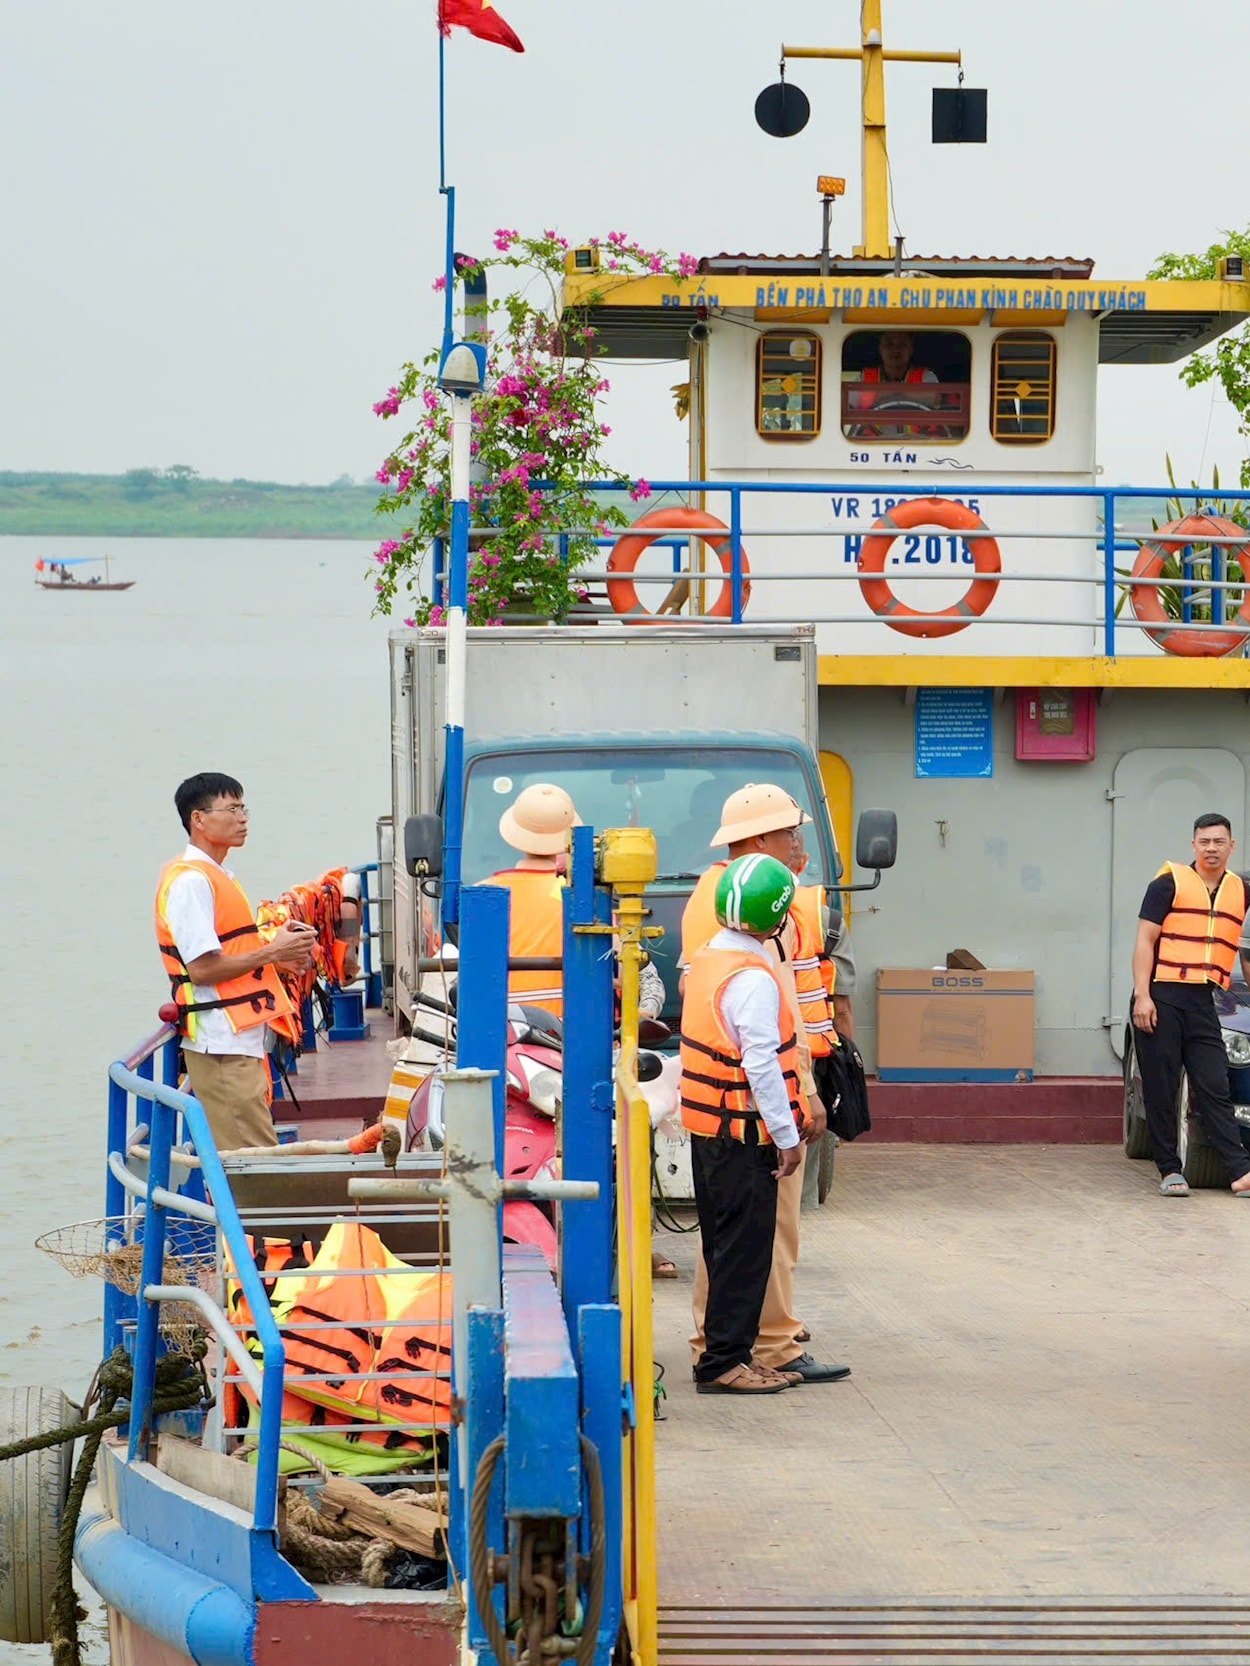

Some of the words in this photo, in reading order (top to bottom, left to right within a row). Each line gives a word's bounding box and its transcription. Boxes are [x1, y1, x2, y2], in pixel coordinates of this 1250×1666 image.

[900, 288, 931, 308] CHU
[936, 289, 976, 309] PHAN
[1023, 285, 1063, 310] CHÀO
[1098, 285, 1147, 310] KHÁCH
[849, 452, 870, 463] 50
[882, 446, 917, 463] TẤN
[831, 498, 860, 518] VR
[844, 535, 975, 565] H.2018
[771, 885, 792, 913] Grab
[931, 976, 984, 988] BOSS
